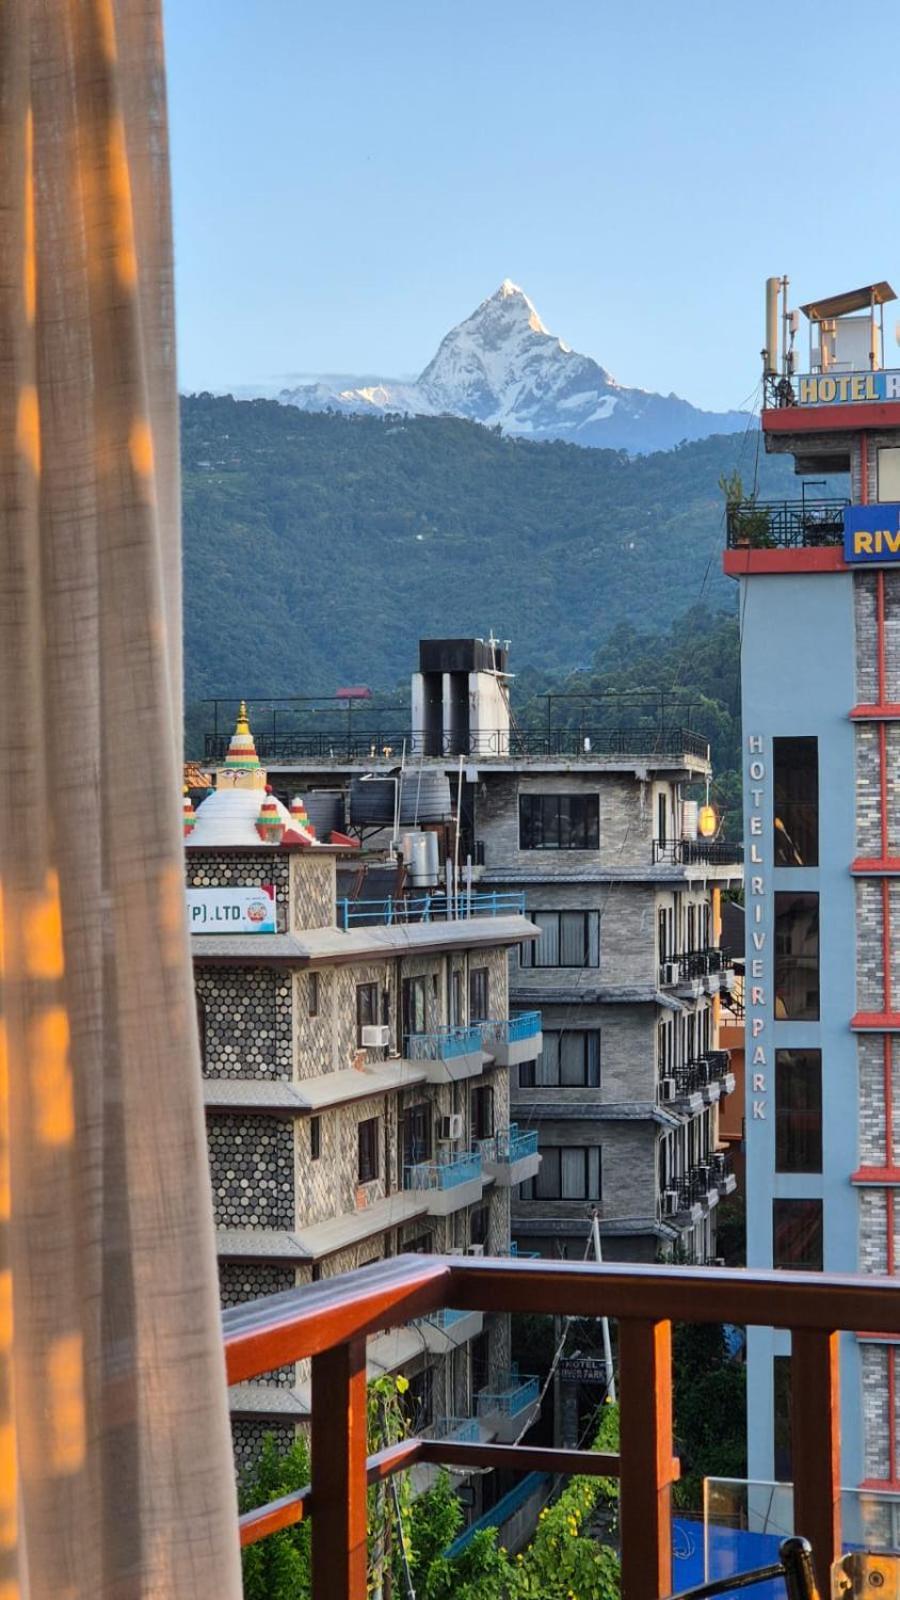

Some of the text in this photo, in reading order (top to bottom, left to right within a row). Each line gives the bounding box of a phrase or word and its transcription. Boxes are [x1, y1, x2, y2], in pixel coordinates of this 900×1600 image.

[801, 376, 880, 403] HOTEL
[748, 735, 767, 1120] HOTEL RIVER PARK
